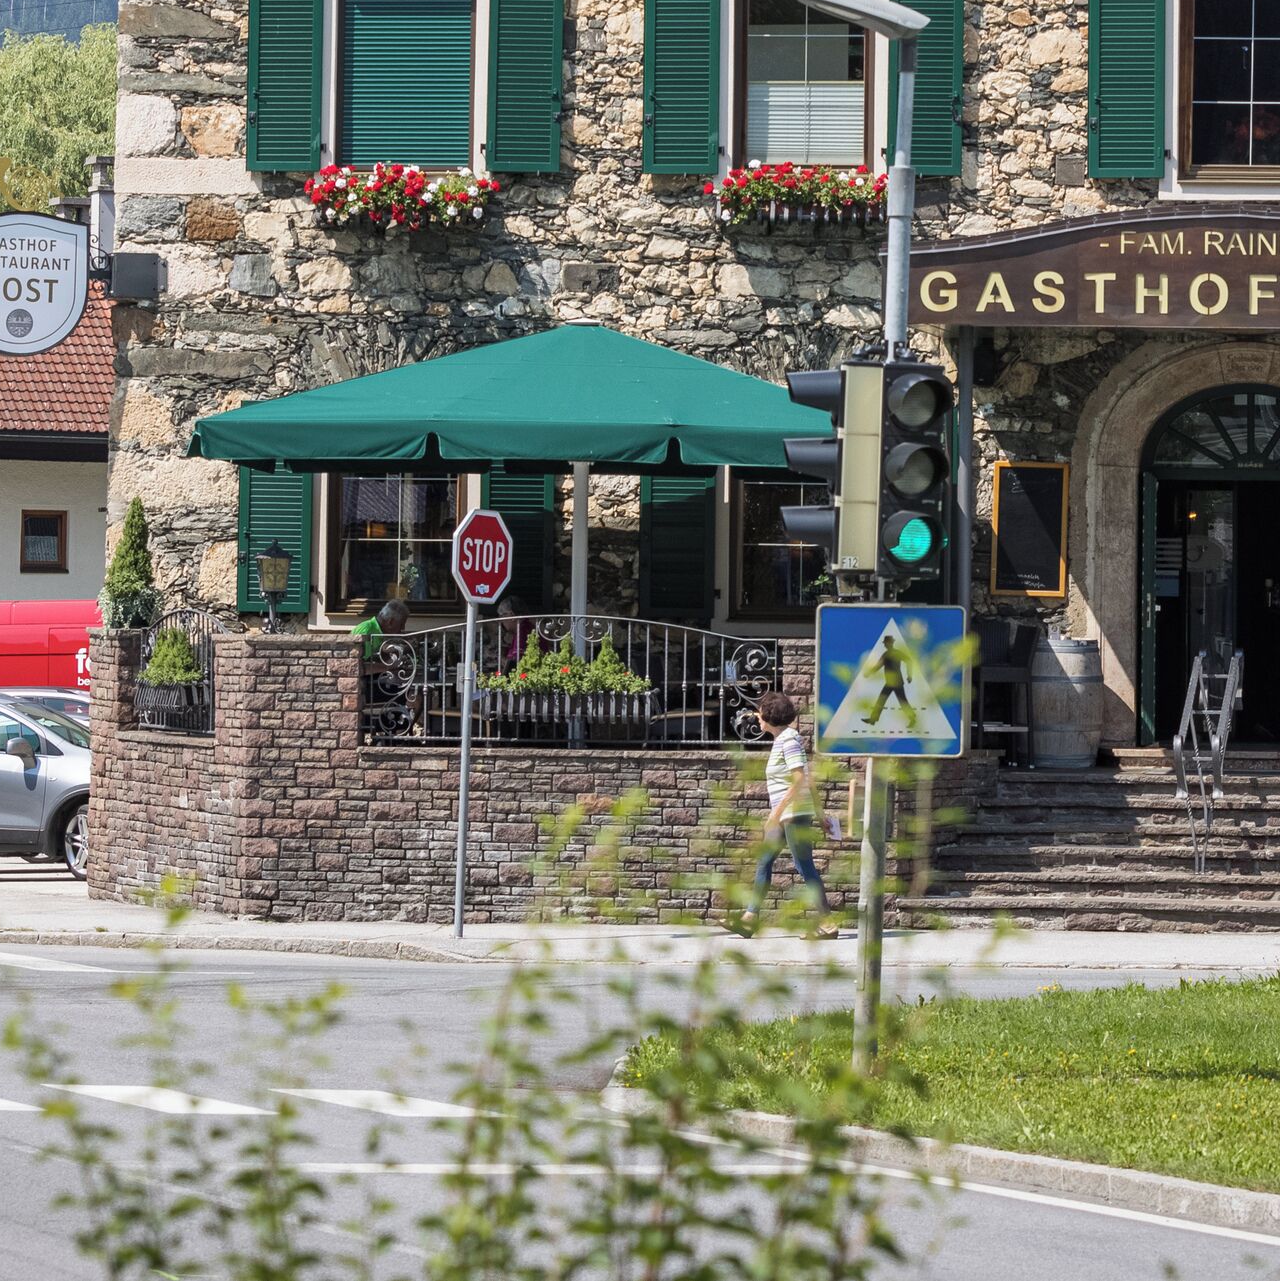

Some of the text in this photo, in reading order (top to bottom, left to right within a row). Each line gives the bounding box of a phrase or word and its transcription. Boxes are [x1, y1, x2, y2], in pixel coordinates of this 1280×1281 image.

[1120, 231, 1192, 255] FAM.
[919, 270, 1278, 316] GASTHOF
[462, 536, 506, 574] STOP
